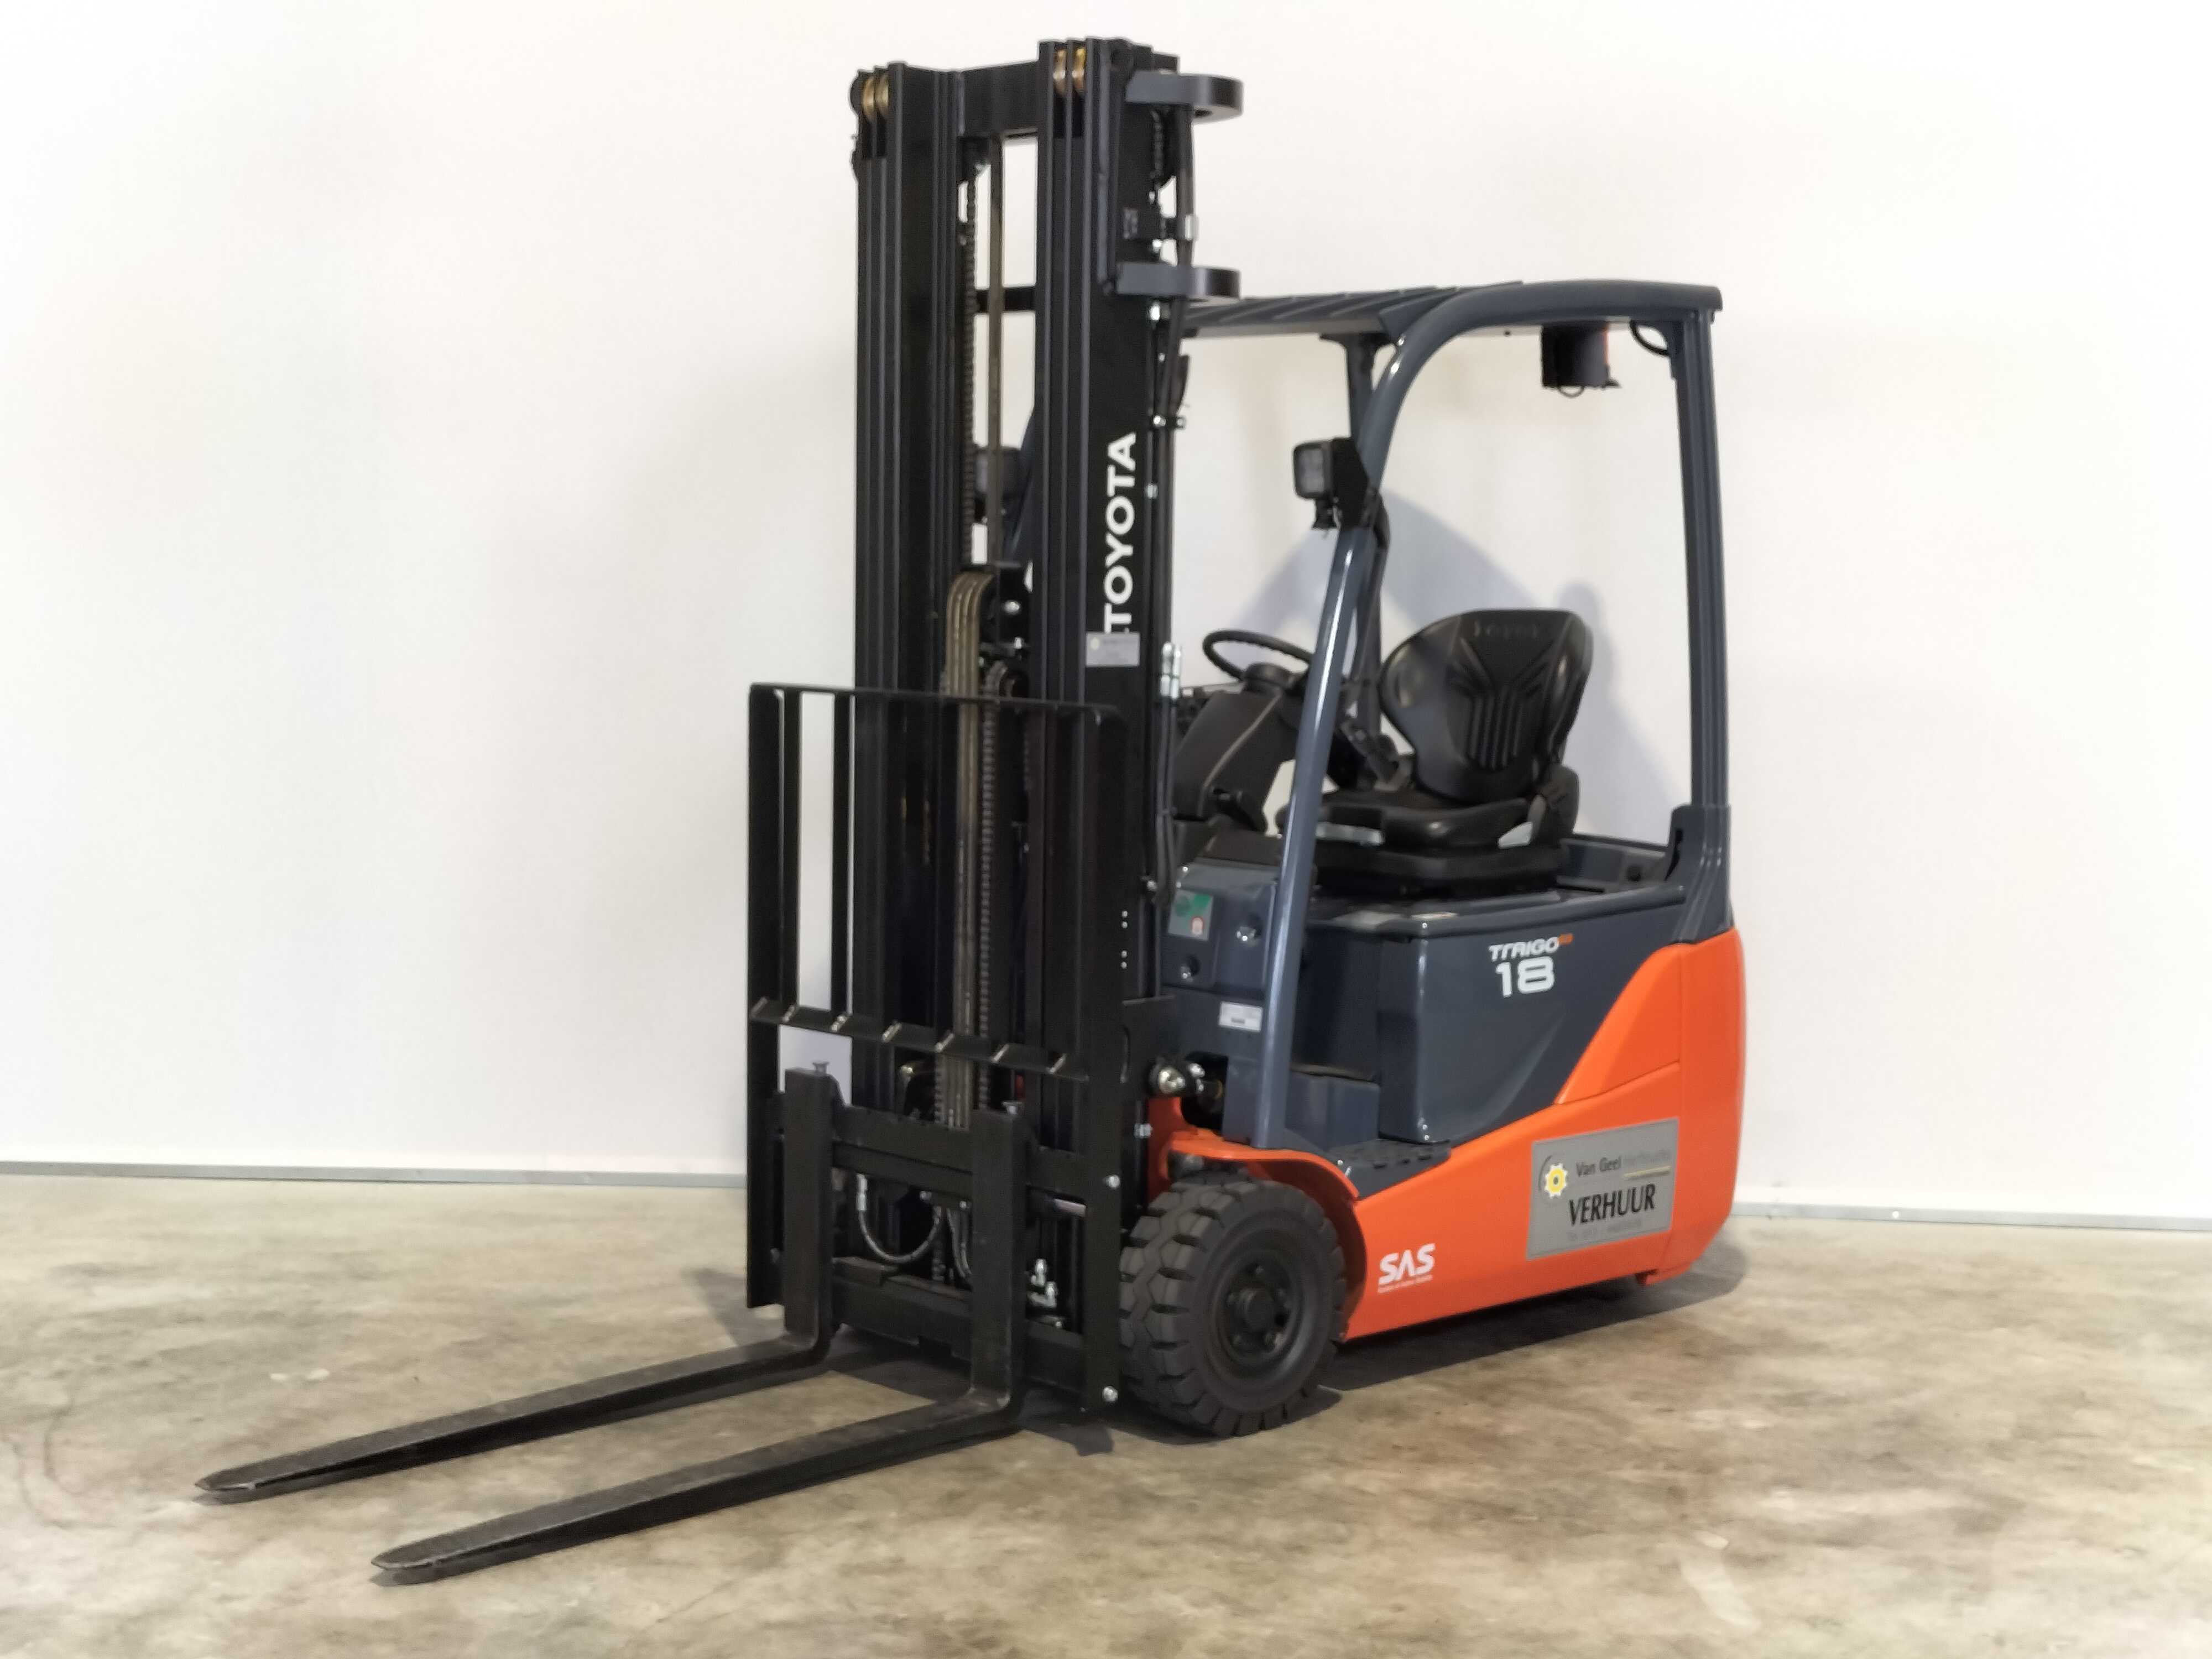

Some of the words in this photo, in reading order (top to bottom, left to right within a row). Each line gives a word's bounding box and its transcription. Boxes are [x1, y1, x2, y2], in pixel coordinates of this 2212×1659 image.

[1104, 431, 1136, 633] TOYOTA
[1496, 956, 1555, 998] 18
[1576, 1161, 1595, 1177] Van
[1569, 1183, 1656, 1227] VERHUUR
[1379, 1243, 1436, 1285] SAS
